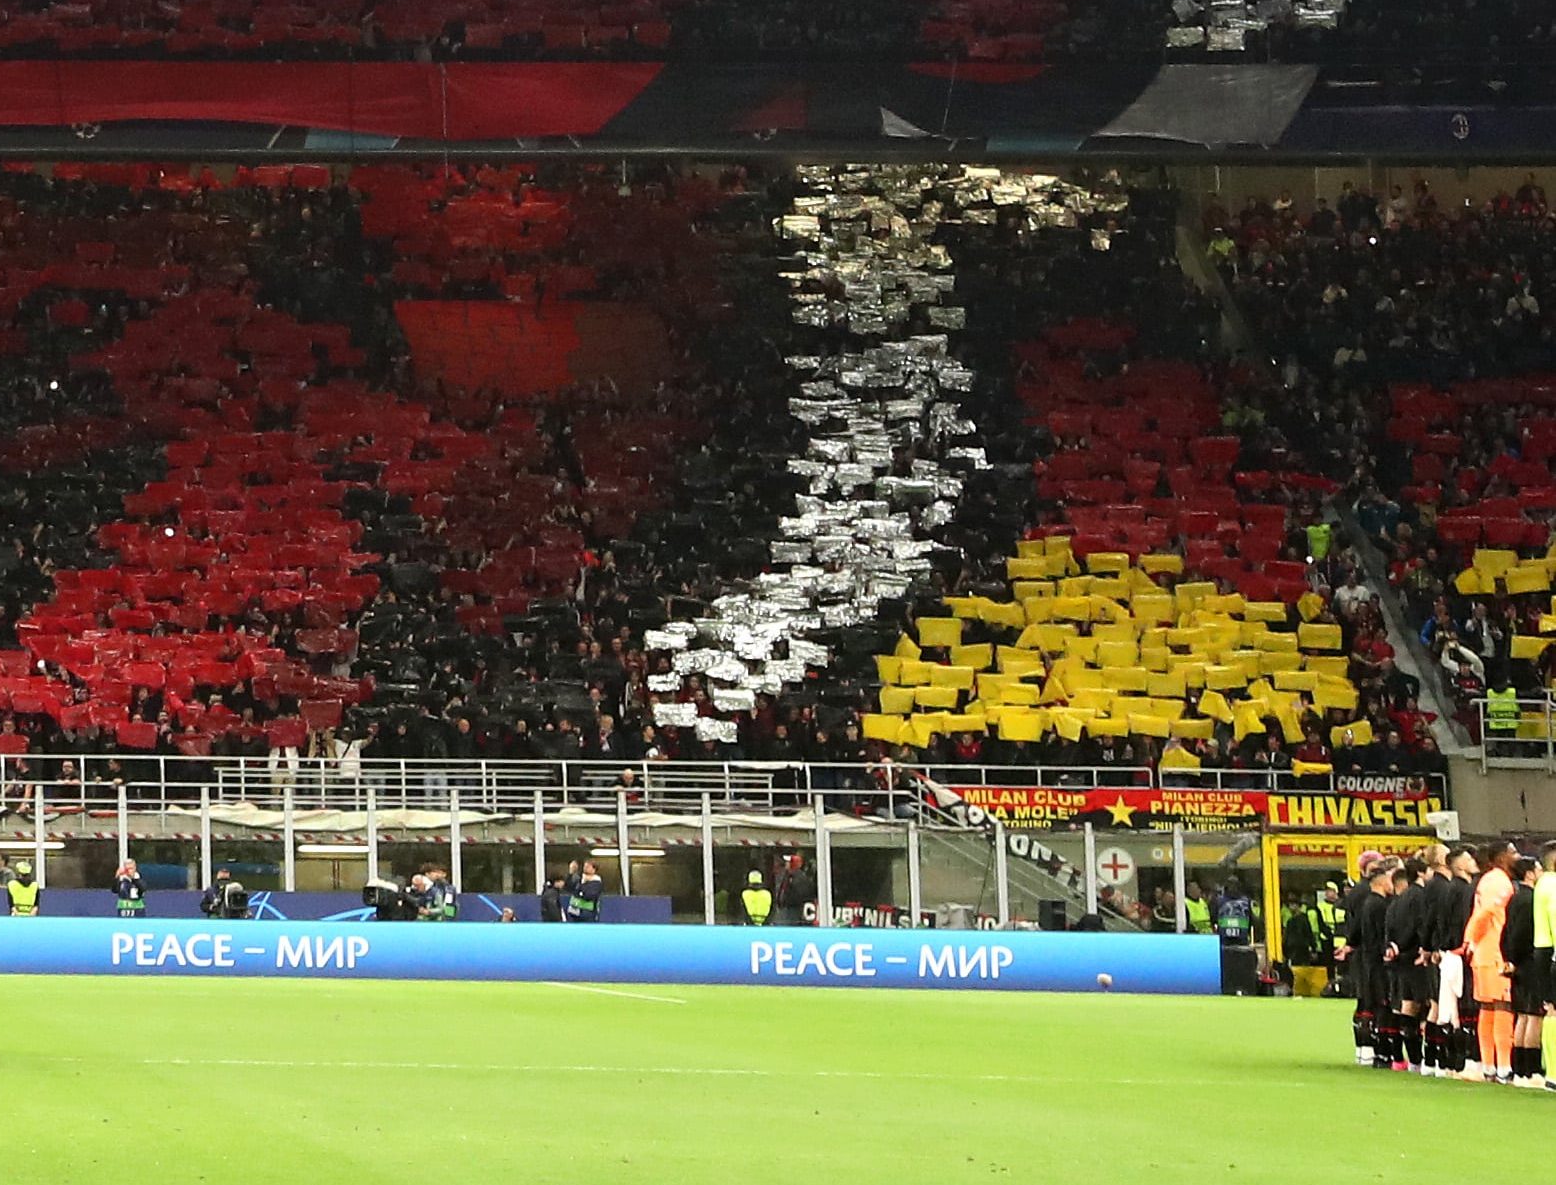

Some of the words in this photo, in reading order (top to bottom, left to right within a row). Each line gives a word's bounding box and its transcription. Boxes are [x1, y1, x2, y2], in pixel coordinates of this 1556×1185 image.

[1338, 775, 1407, 793] COLOGNE
[964, 789, 1028, 805] MILAN
[1034, 790, 1086, 807] CLUB
[1161, 791, 1204, 802] MILAN
[1208, 792, 1243, 803] CLUB
[1150, 800, 1256, 816] PIANEZZA
[111, 932, 236, 967] PEACE
[276, 935, 370, 969] МИР
[750, 941, 877, 976] PEACE
[918, 944, 1014, 979] МИР
